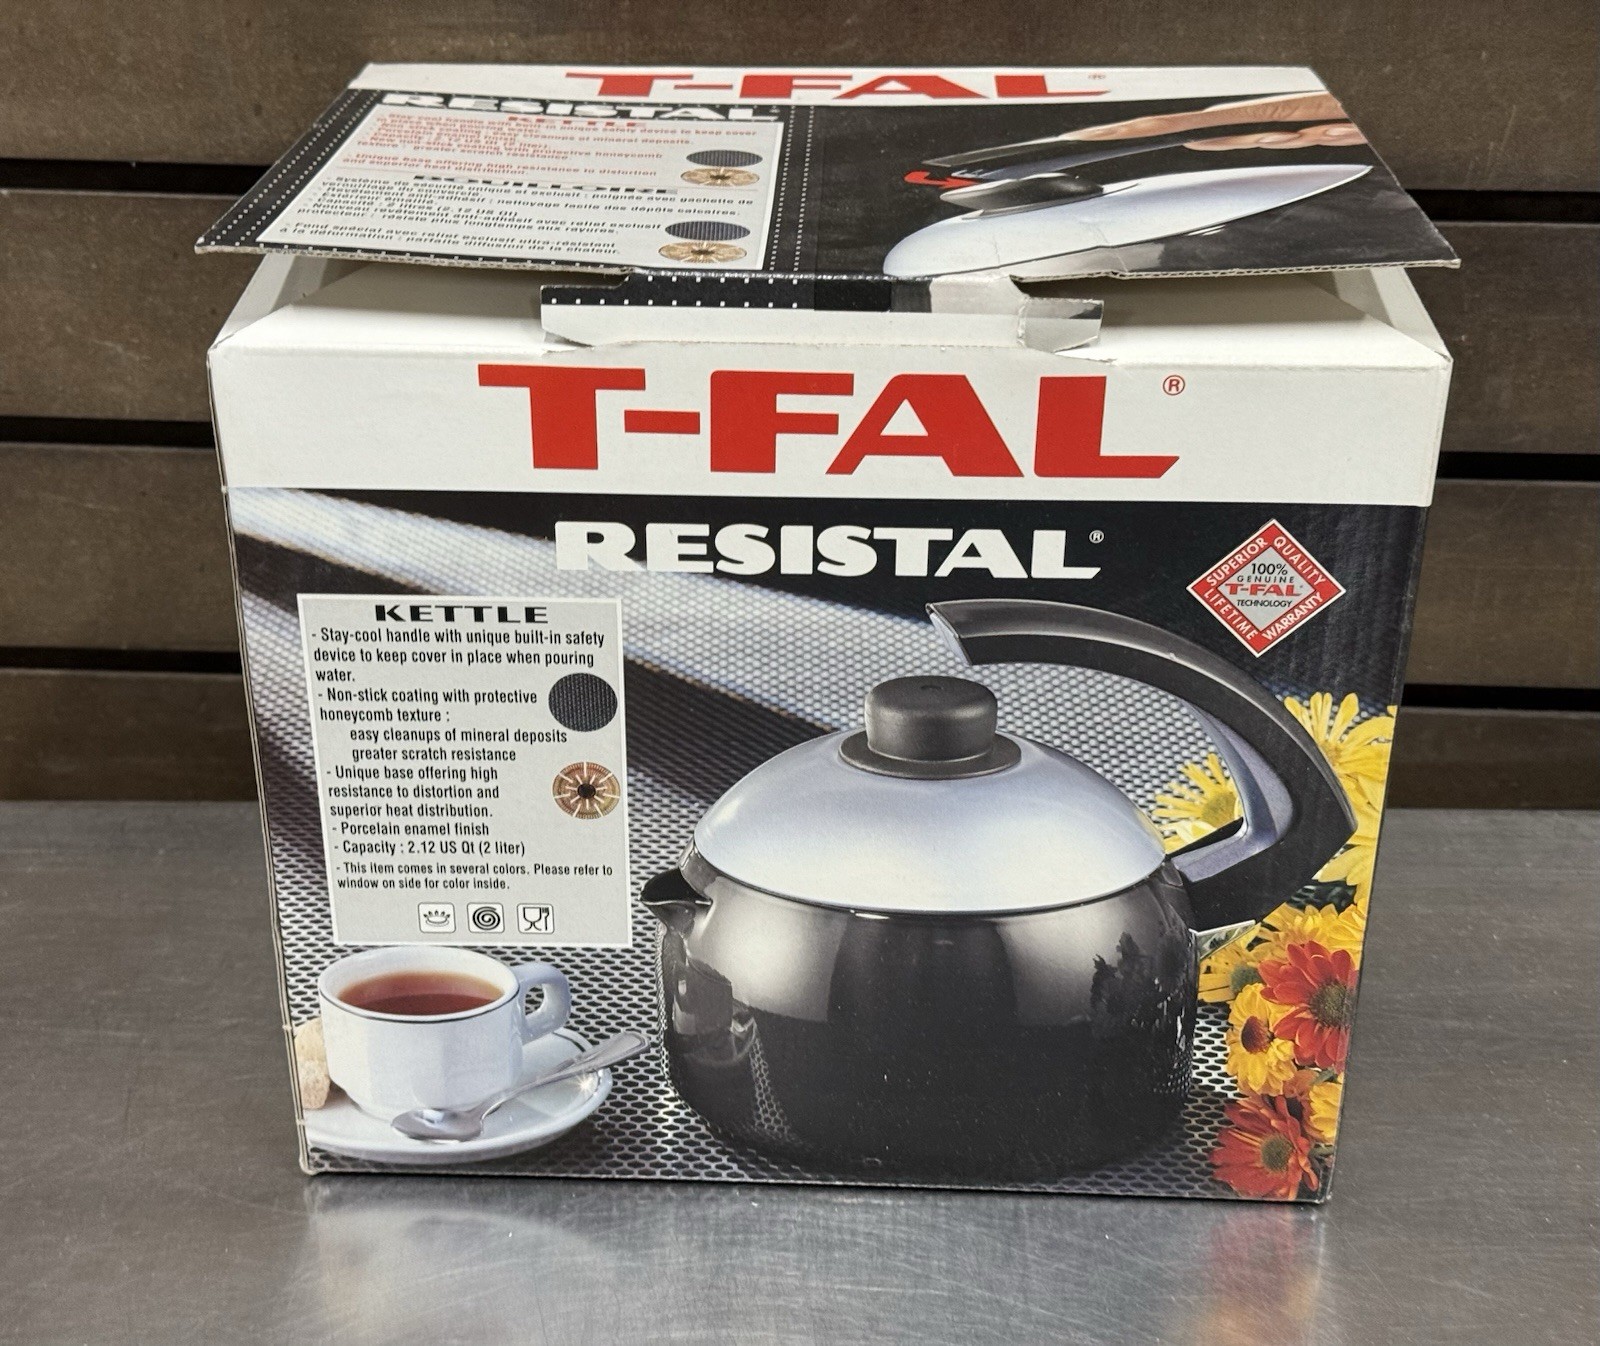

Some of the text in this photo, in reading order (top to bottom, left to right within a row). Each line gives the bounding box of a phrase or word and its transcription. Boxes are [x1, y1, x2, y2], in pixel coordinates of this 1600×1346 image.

[566, 73, 1109, 100] T-FAL
[478, 364, 1180, 478] T-FAL
[555, 521, 1101, 579] RESISTAL
[1206, 537, 1268, 586] SUPERIOR
[1251, 563, 1288, 575] 100%
[1274, 536, 1326, 586] QUALITY
[1225, 583, 1302, 596] T-FAL
[374, 604, 548, 624] KETTLE
[1203, 589, 1258, 640] LIFETIME
[1262, 592, 1323, 641] WARRANTY
[320, 626, 604, 648] Stay-cool handle with unique built-in safety
[313, 647, 594, 668] device to keep cover in place when pouring
[315, 668, 355, 682] water.
[326, 687, 537, 705] Non-stick coating with protective
[319, 707, 441, 724] honeycomb texture
[349, 727, 567, 745] easy cleanups of mineral deposits
[352, 747, 516, 762] greater scratch resistance
[335, 764, 498, 783] Unique base offering high
[328, 784, 499, 799] resistance to distortion and
[329, 803, 493, 818] superior heat distribution.
[340, 821, 489, 836] Porcelain enamel finish
[342, 839, 396, 855] Capacity
[407, 840, 436, 854] 2.12
[439, 840, 457, 854] US
[461, 840, 475, 854] Qt
[494, 841, 525, 857] liter)
[343, 861, 613, 876] This item comes in several colors. Please refer to
[337, 876, 509, 889] window on side for color inside.
